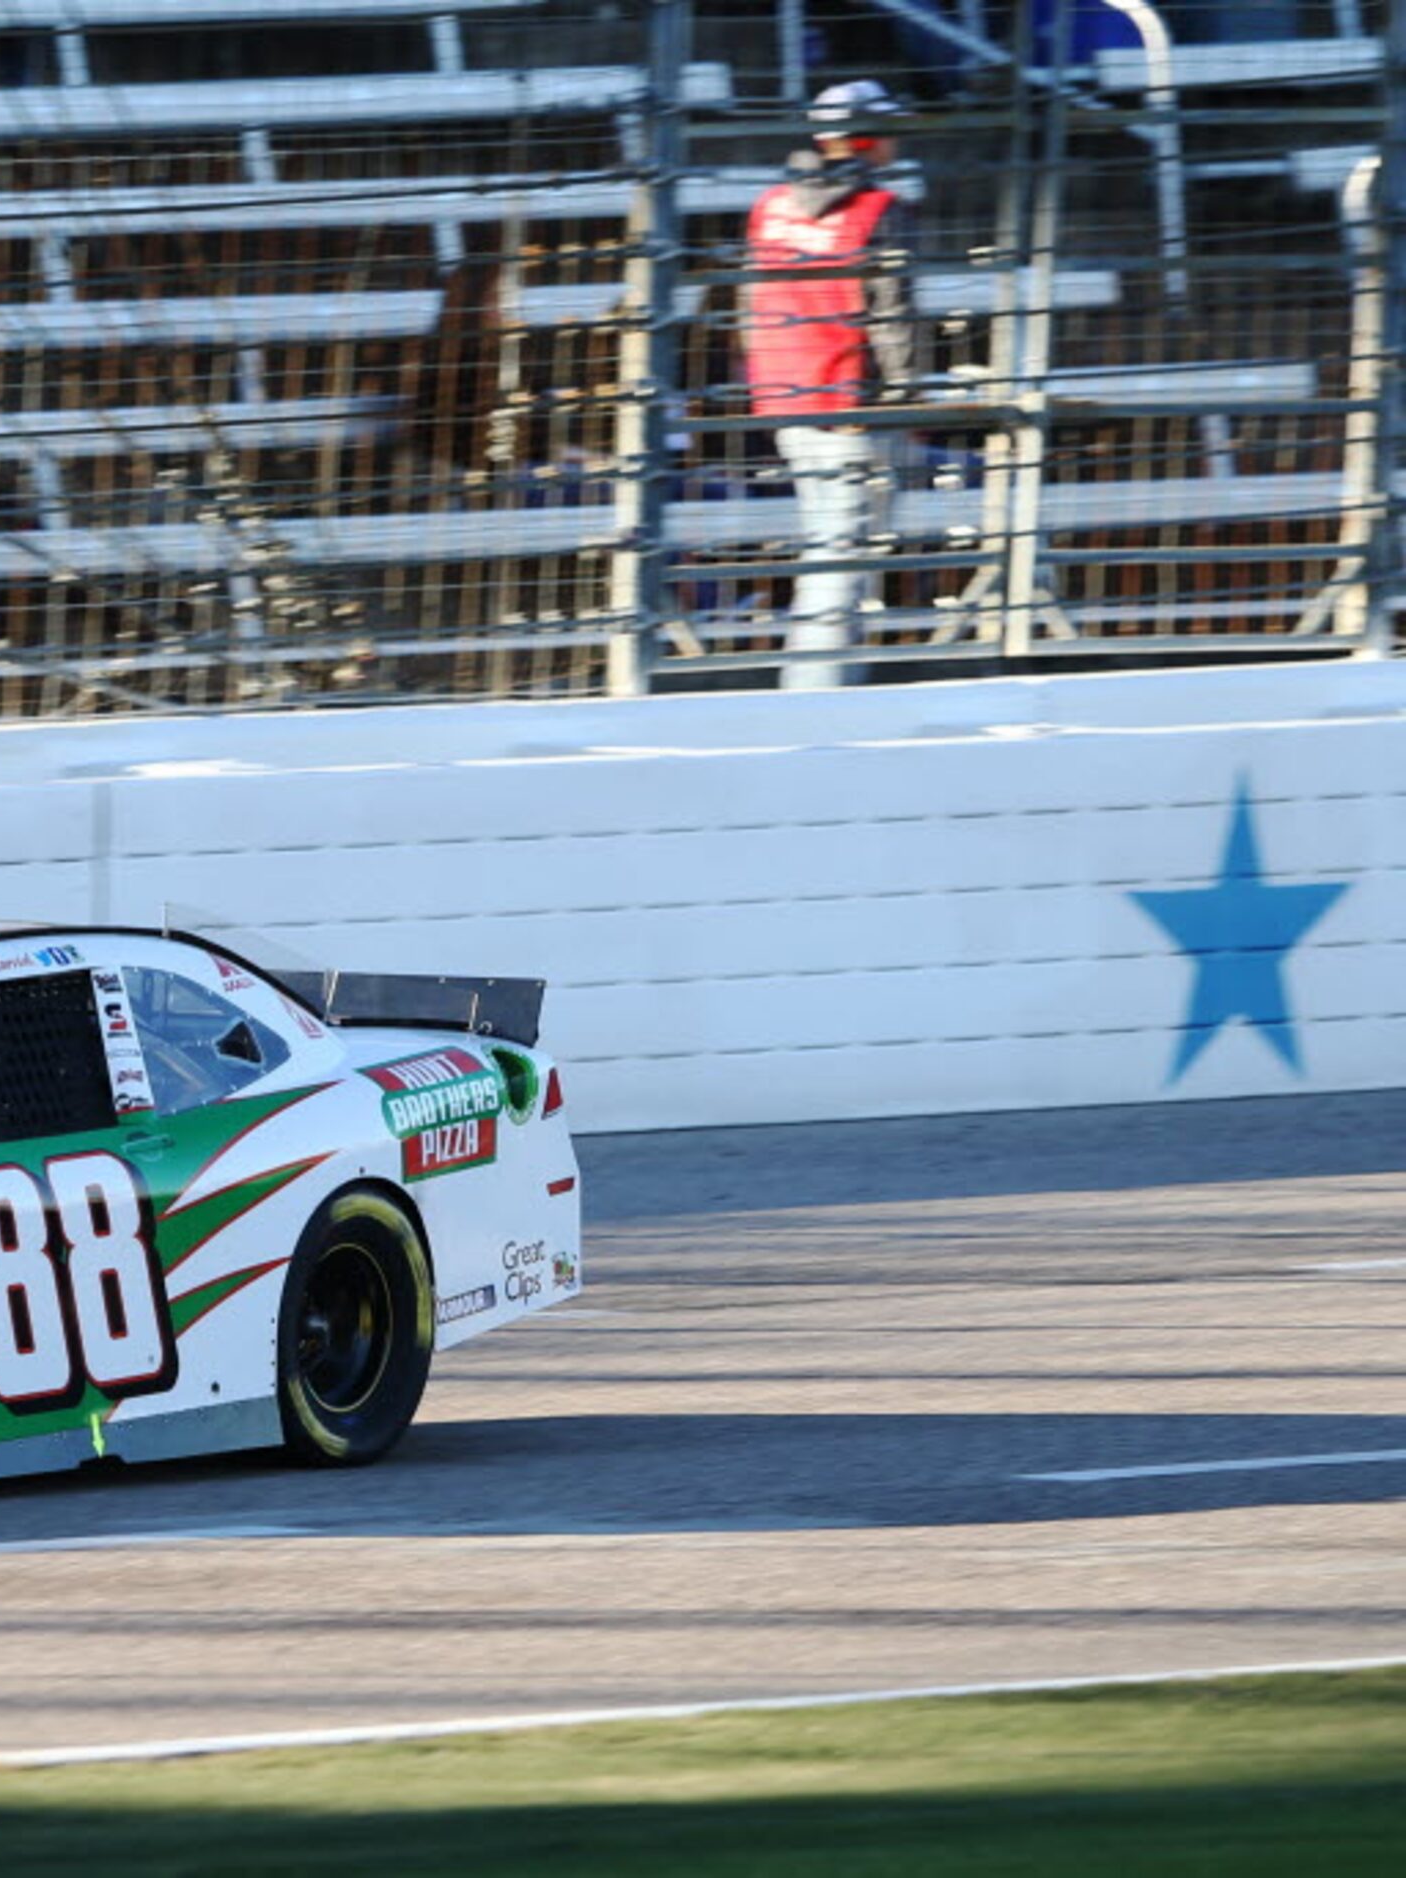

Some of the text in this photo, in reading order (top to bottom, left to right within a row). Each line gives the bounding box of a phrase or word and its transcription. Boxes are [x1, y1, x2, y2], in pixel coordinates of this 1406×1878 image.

[386, 1054, 464, 1091] HUNT
[388, 1076, 499, 1132] BROTHERS
[421, 1119, 479, 1168] PIZZA
[501, 1240, 546, 1270] Great
[505, 1271, 542, 1307] Clips
